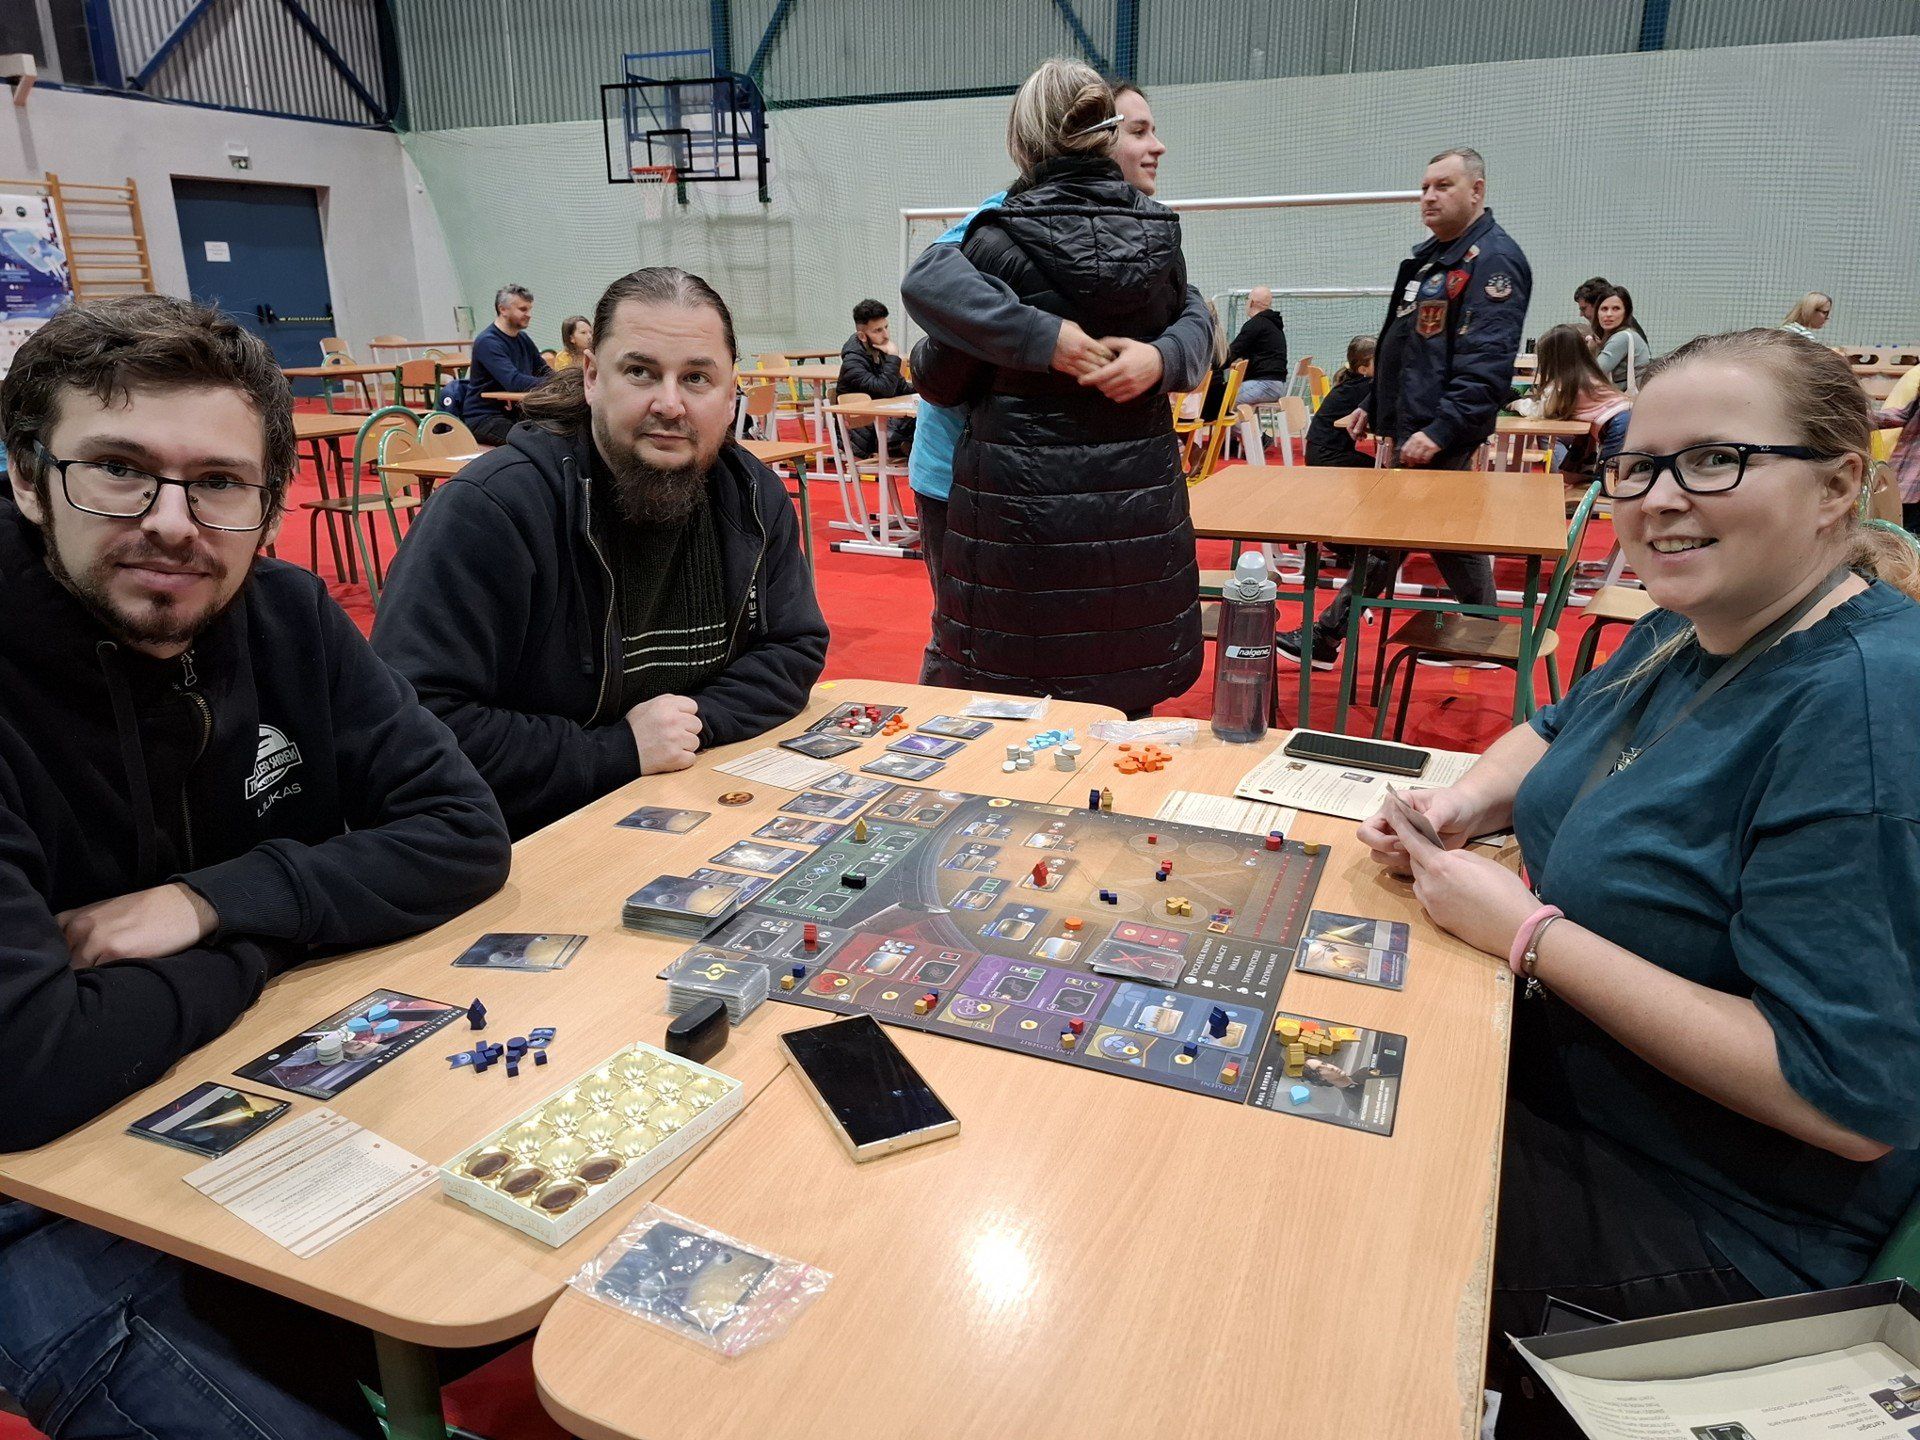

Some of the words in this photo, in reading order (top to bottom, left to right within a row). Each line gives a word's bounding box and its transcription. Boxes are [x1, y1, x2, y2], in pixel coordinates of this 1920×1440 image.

[1238, 647, 1270, 659] nalgene
[257, 783, 301, 817] LUKAS
[1214, 944, 1228, 963] GRACZY
[1207, 961, 1222, 976] TURY
[1228, 955, 1242, 971] WALKA
